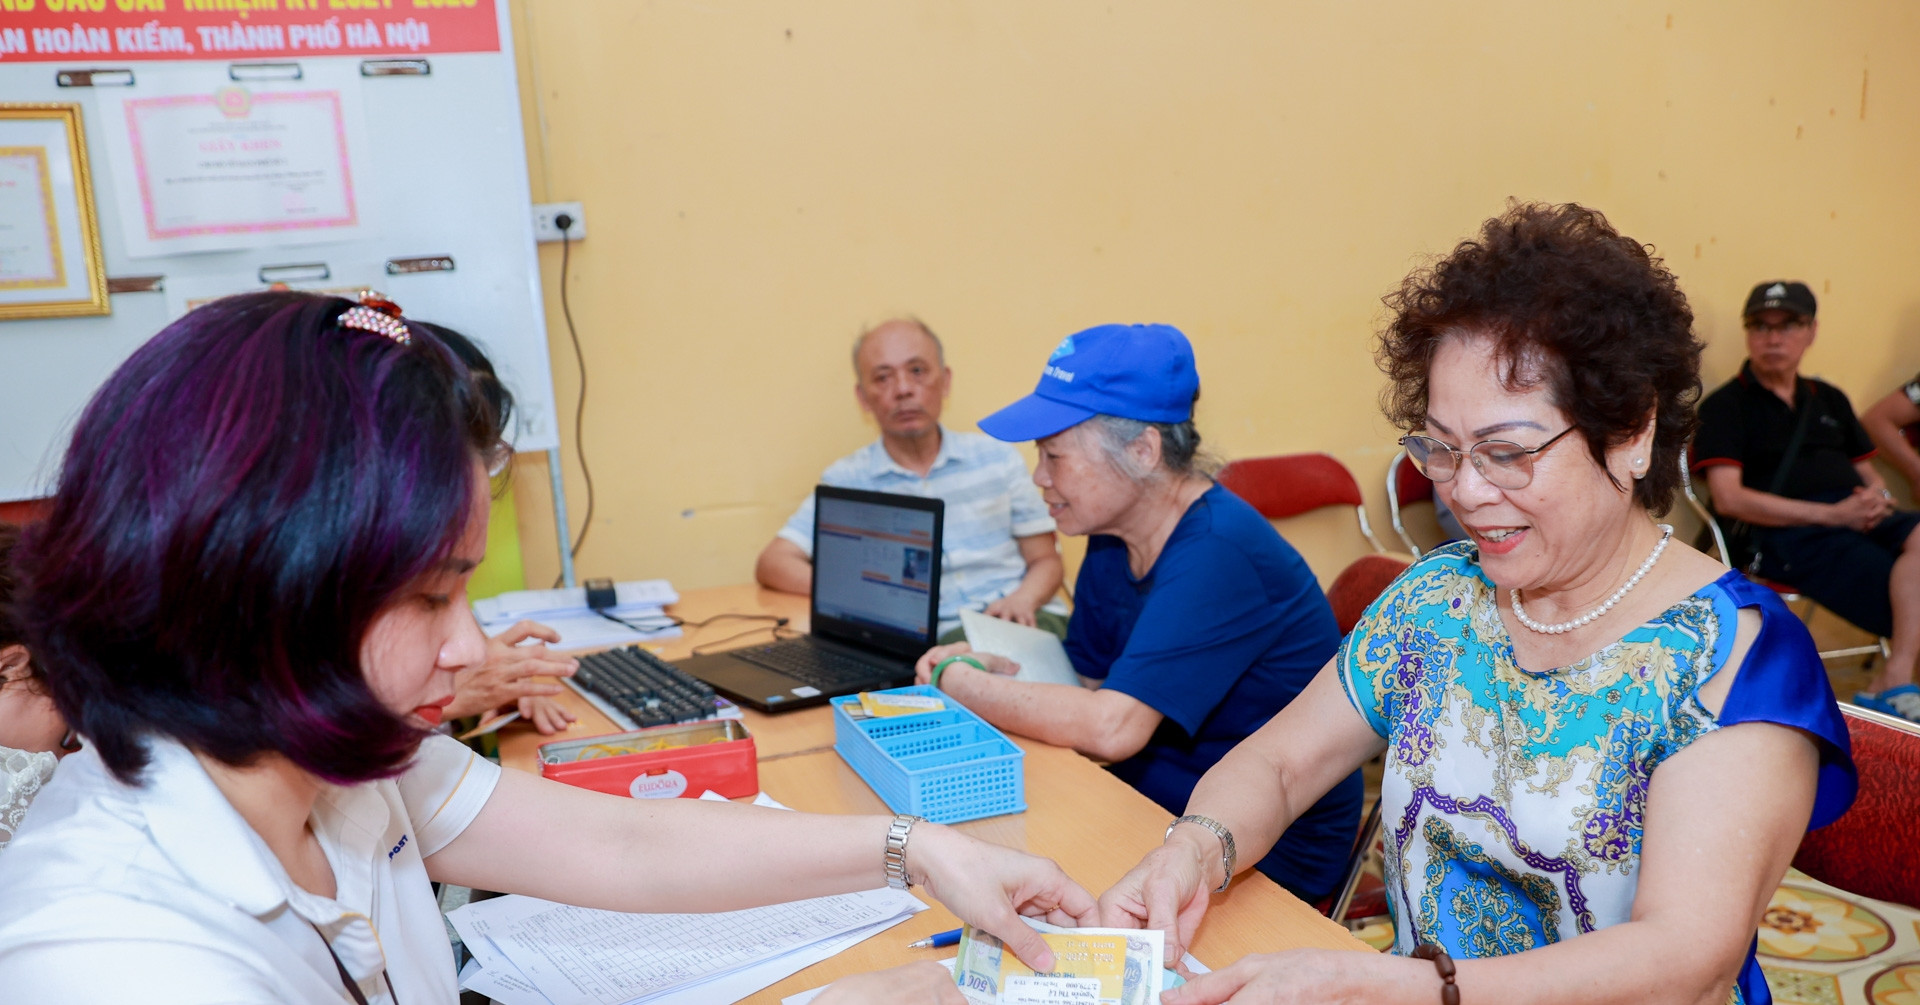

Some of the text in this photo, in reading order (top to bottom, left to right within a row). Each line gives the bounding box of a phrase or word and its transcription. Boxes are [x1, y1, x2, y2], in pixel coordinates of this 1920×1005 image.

[32, 22, 111, 53] HOÀN
[115, 19, 194, 54] KIẾM,
[197, 20, 284, 50] THÀNH
[288, 16, 341, 49] PHỐ
[345, 18, 382, 48] HÀ
[385, 17, 430, 51] NỘI
[388, 834, 408, 861] POST
